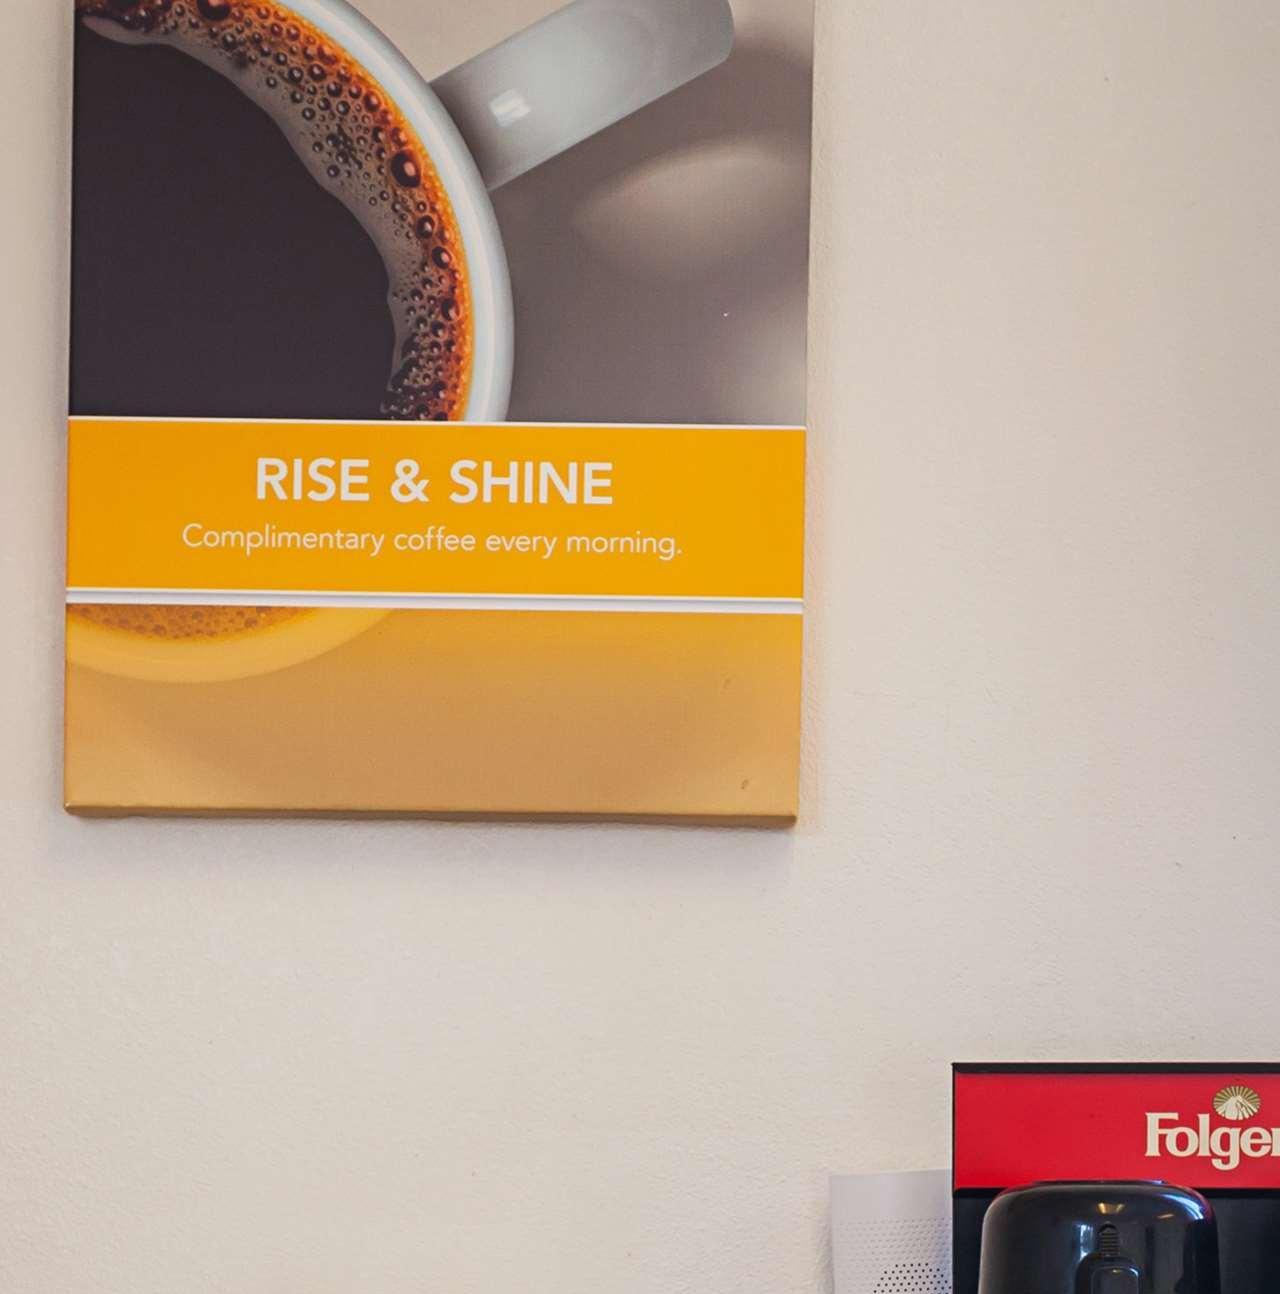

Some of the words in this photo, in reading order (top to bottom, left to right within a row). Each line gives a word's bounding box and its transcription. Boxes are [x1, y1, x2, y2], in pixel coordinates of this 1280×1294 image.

[256, 457, 370, 502] RISE
[390, 458, 429, 504] &
[449, 459, 613, 505] SHINE
[181, 523, 385, 557] Complimentary
[393, 525, 477, 552] coffee
[485, 535, 558, 559] every
[566, 531, 683, 561] morning.
